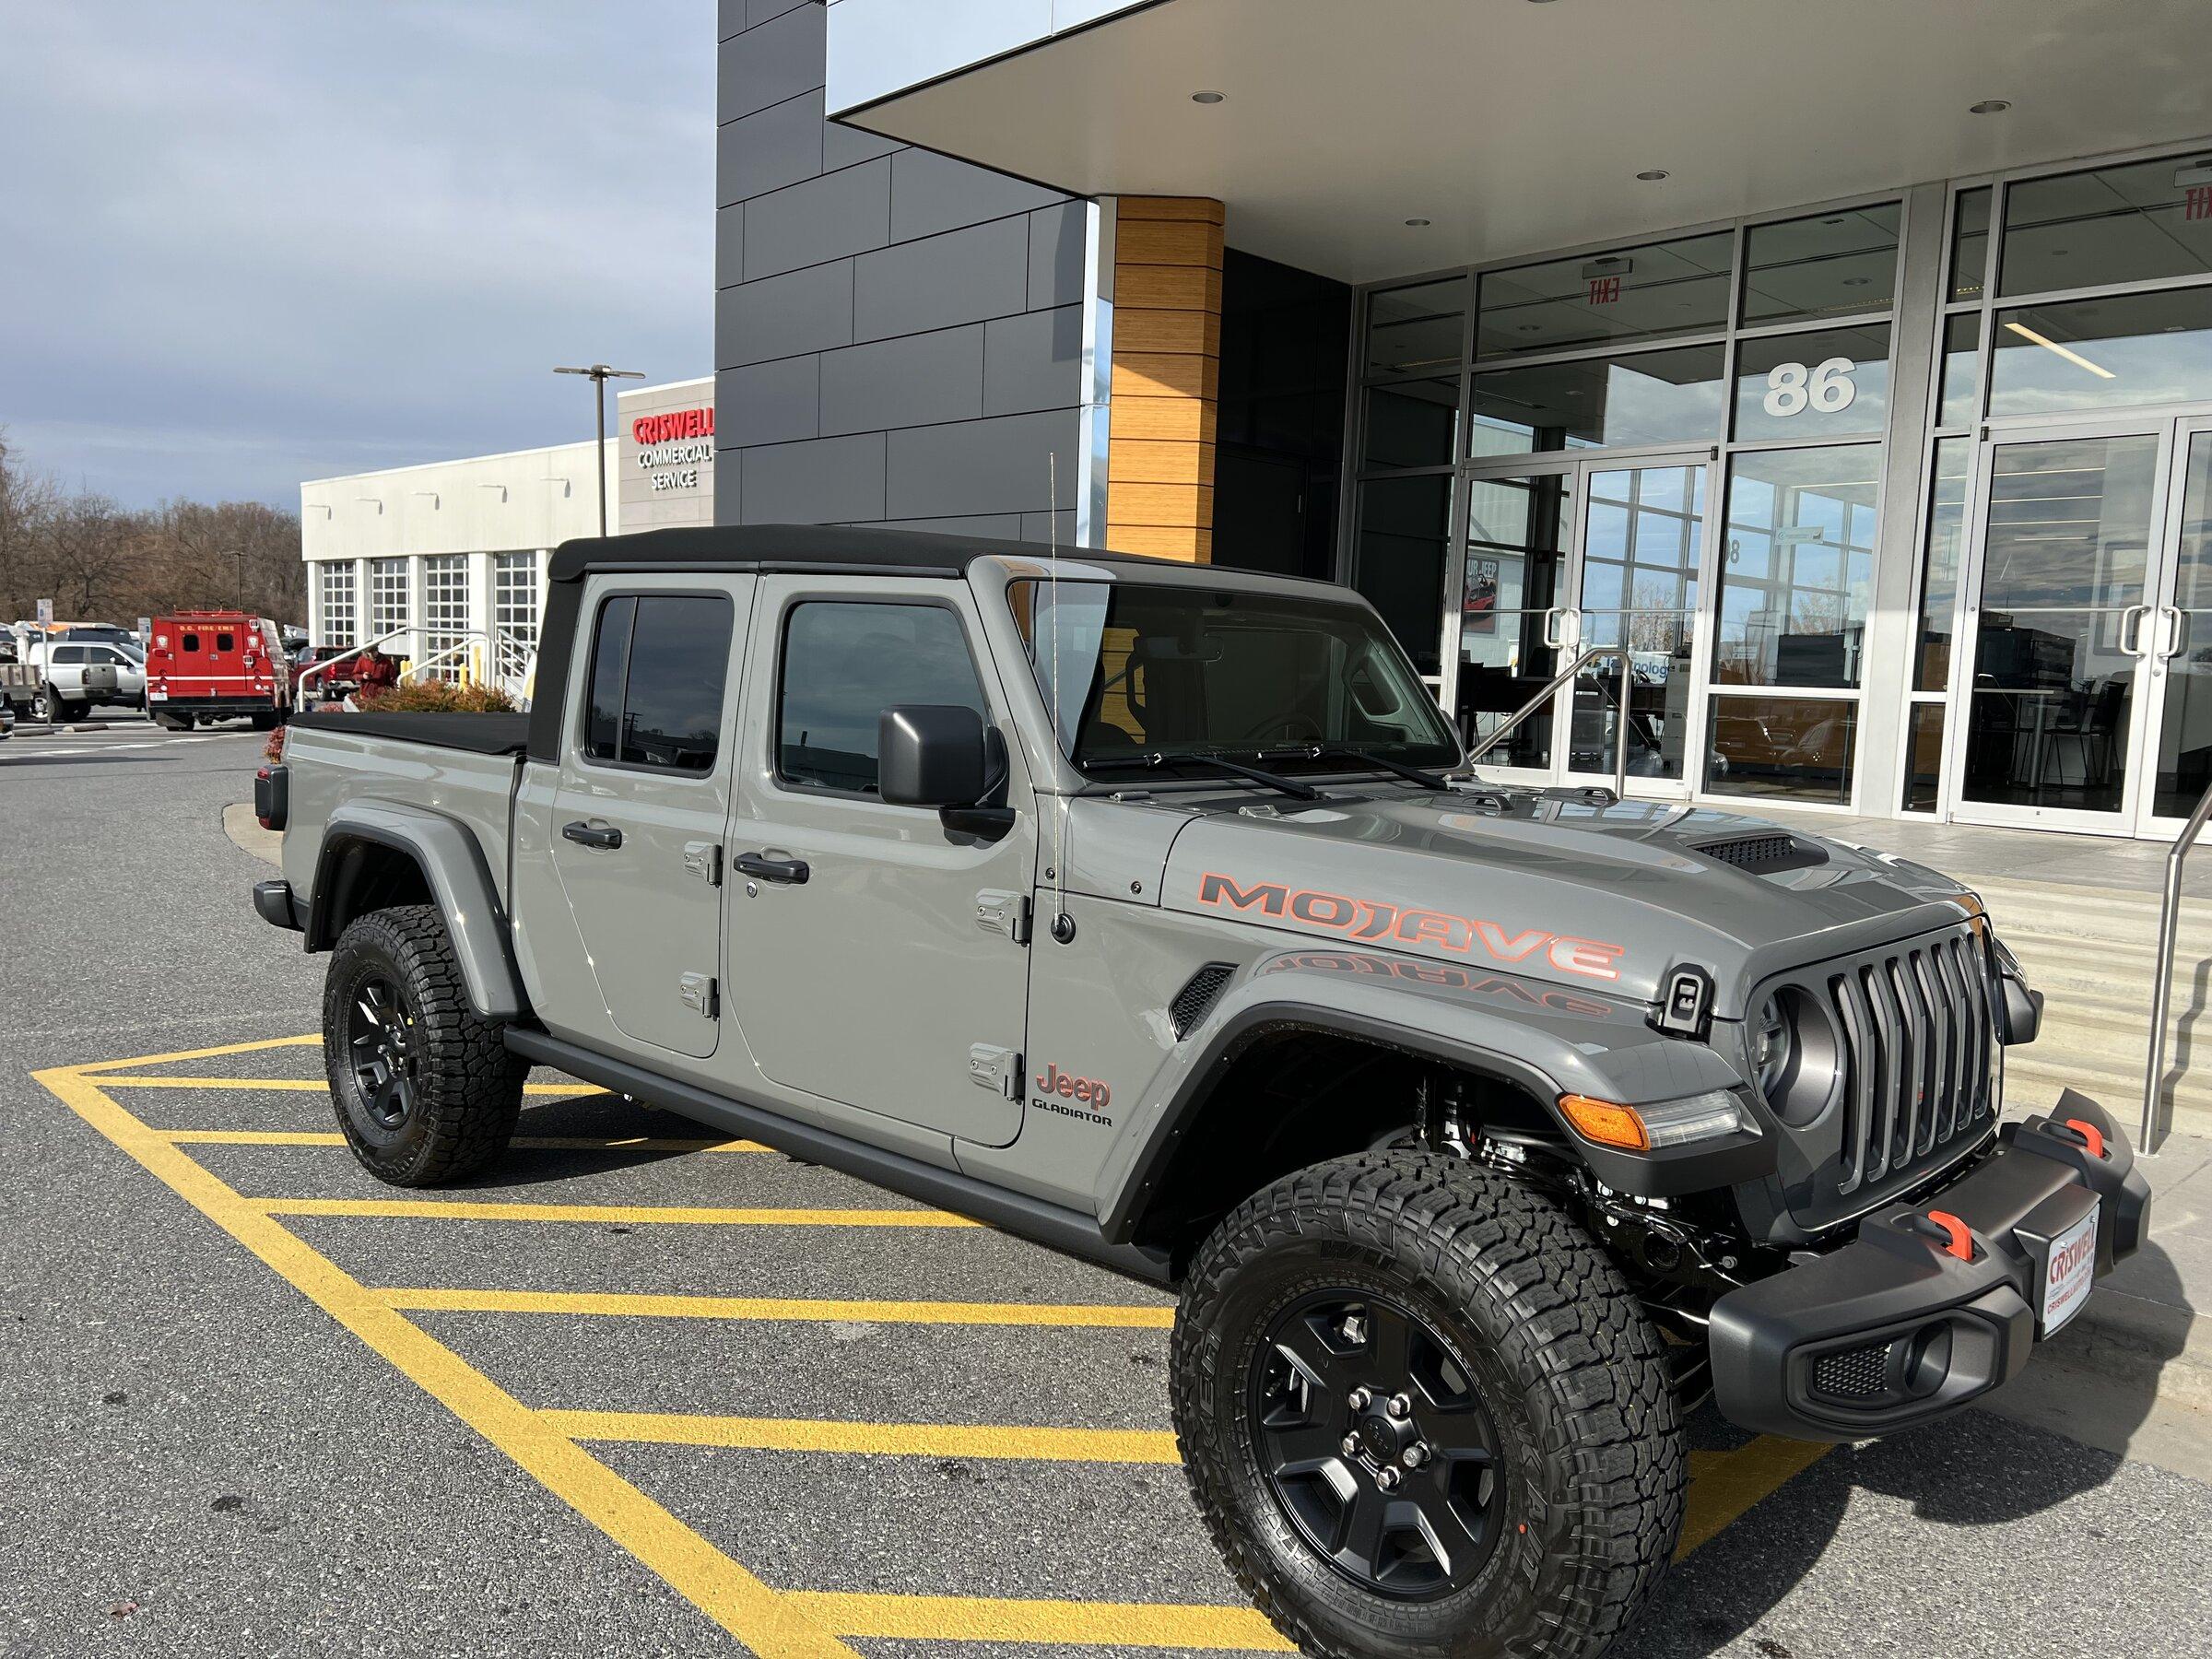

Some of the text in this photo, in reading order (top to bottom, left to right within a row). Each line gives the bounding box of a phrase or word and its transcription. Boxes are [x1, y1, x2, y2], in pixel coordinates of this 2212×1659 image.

[1763, 357, 1855, 418] 86
[632, 406, 715, 446] CRISWELL
[637, 445, 712, 468] COMMERCIAL
[651, 469, 698, 491] SERVICE
[1466, 559, 1478, 576] UR
[1200, 871, 1625, 982] MOJAVE
[1036, 1062, 1110, 1112] Jeep
[1031, 1098, 1112, 1127] GLADIATOR
[2050, 1223, 2095, 1285] CRISWELL
